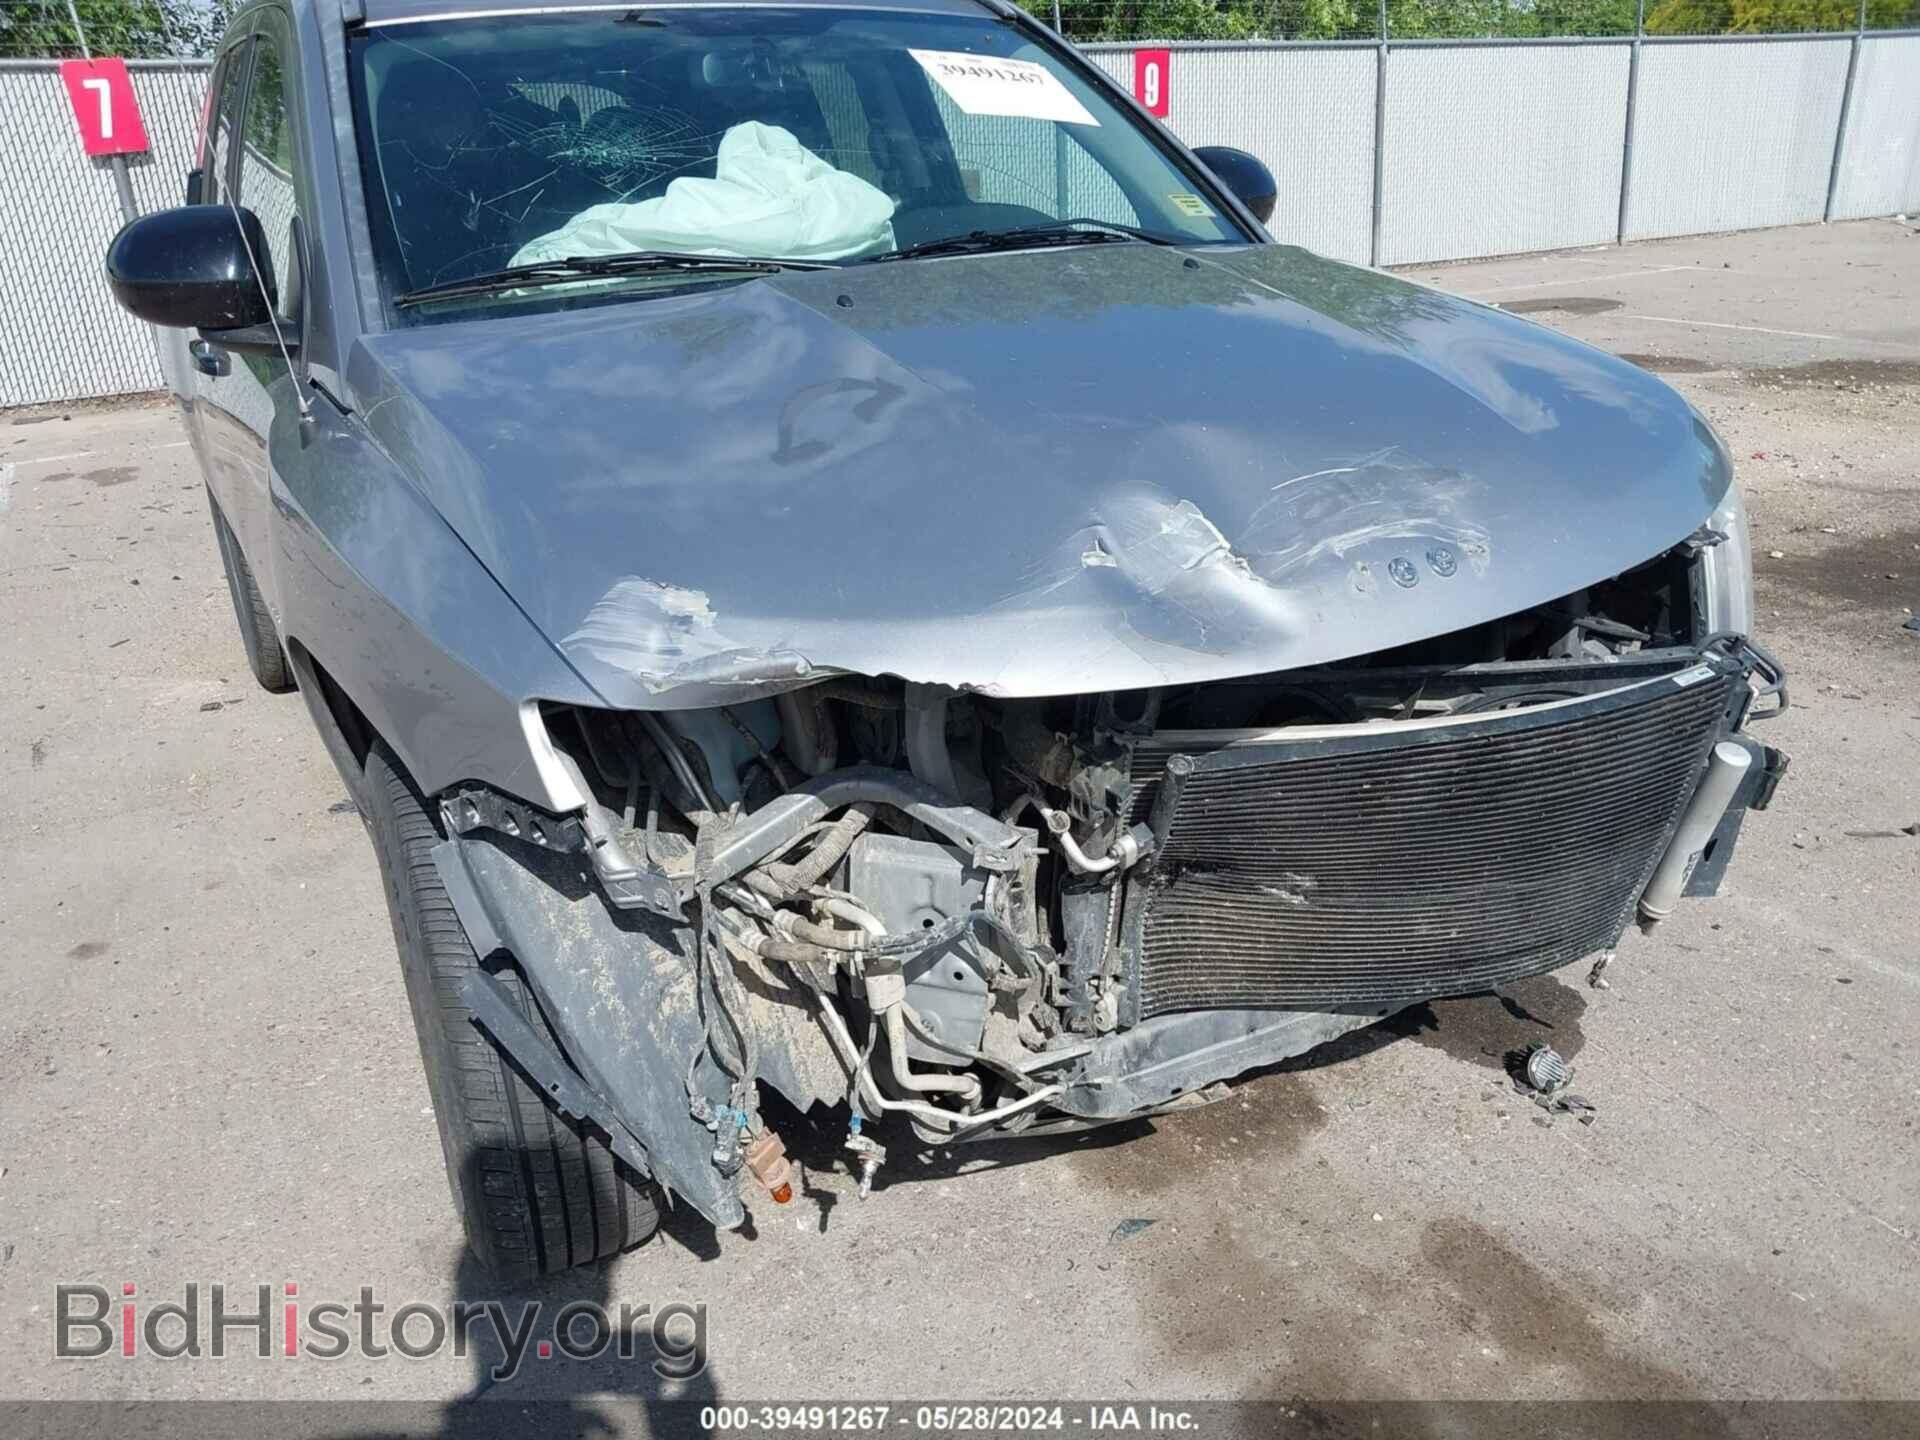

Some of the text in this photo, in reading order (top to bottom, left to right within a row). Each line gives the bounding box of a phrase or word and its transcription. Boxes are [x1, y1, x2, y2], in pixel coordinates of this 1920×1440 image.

[938, 63, 1044, 85] 39491267
[1145, 62, 1159, 107] 9
[82, 78, 113, 139] 7
